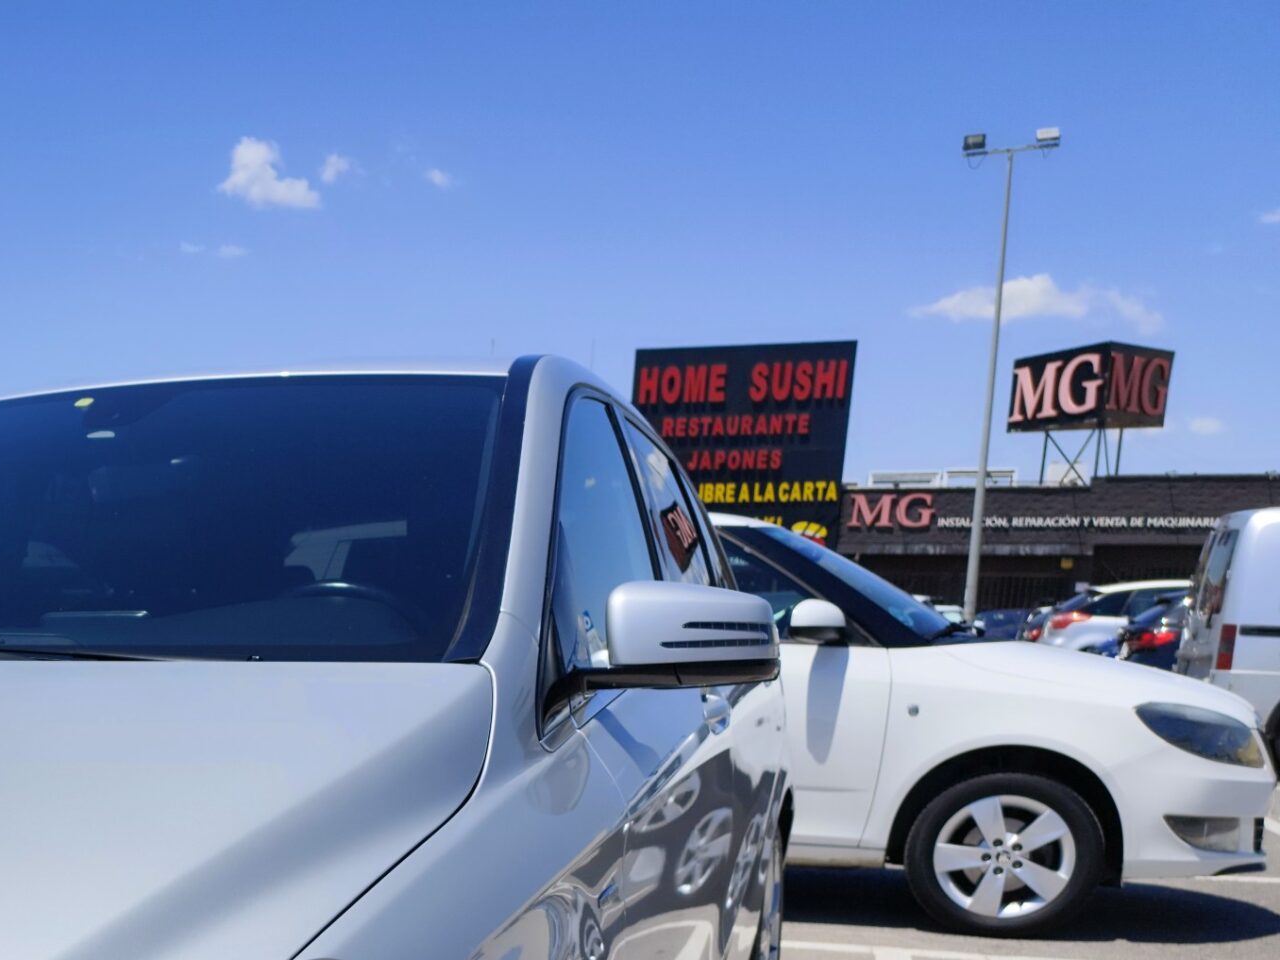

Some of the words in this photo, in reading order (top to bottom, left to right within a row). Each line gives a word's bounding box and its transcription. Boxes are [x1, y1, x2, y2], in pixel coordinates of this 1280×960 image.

[638, 364, 727, 404] HOME
[749, 359, 848, 401] SUSHI
[1008, 353, 1104, 422] MG
[1105, 352, 1170, 416] MG
[662, 413, 810, 437] RESTAURANTE
[687, 449, 782, 470] JAPONES
[698, 482, 736, 503] IBRE
[738, 482, 750, 503] A
[754, 482, 775, 502] LA
[778, 481, 838, 502] CARTA
[847, 493, 935, 527] MG
[937, 515, 1009, 528] INSTALIÓN,
[1012, 514, 1080, 528] REPARACIÓN
[1083, 516, 1091, 528] Y
[1093, 516, 1127, 527] VENTA
[1130, 516, 1144, 527] DE
